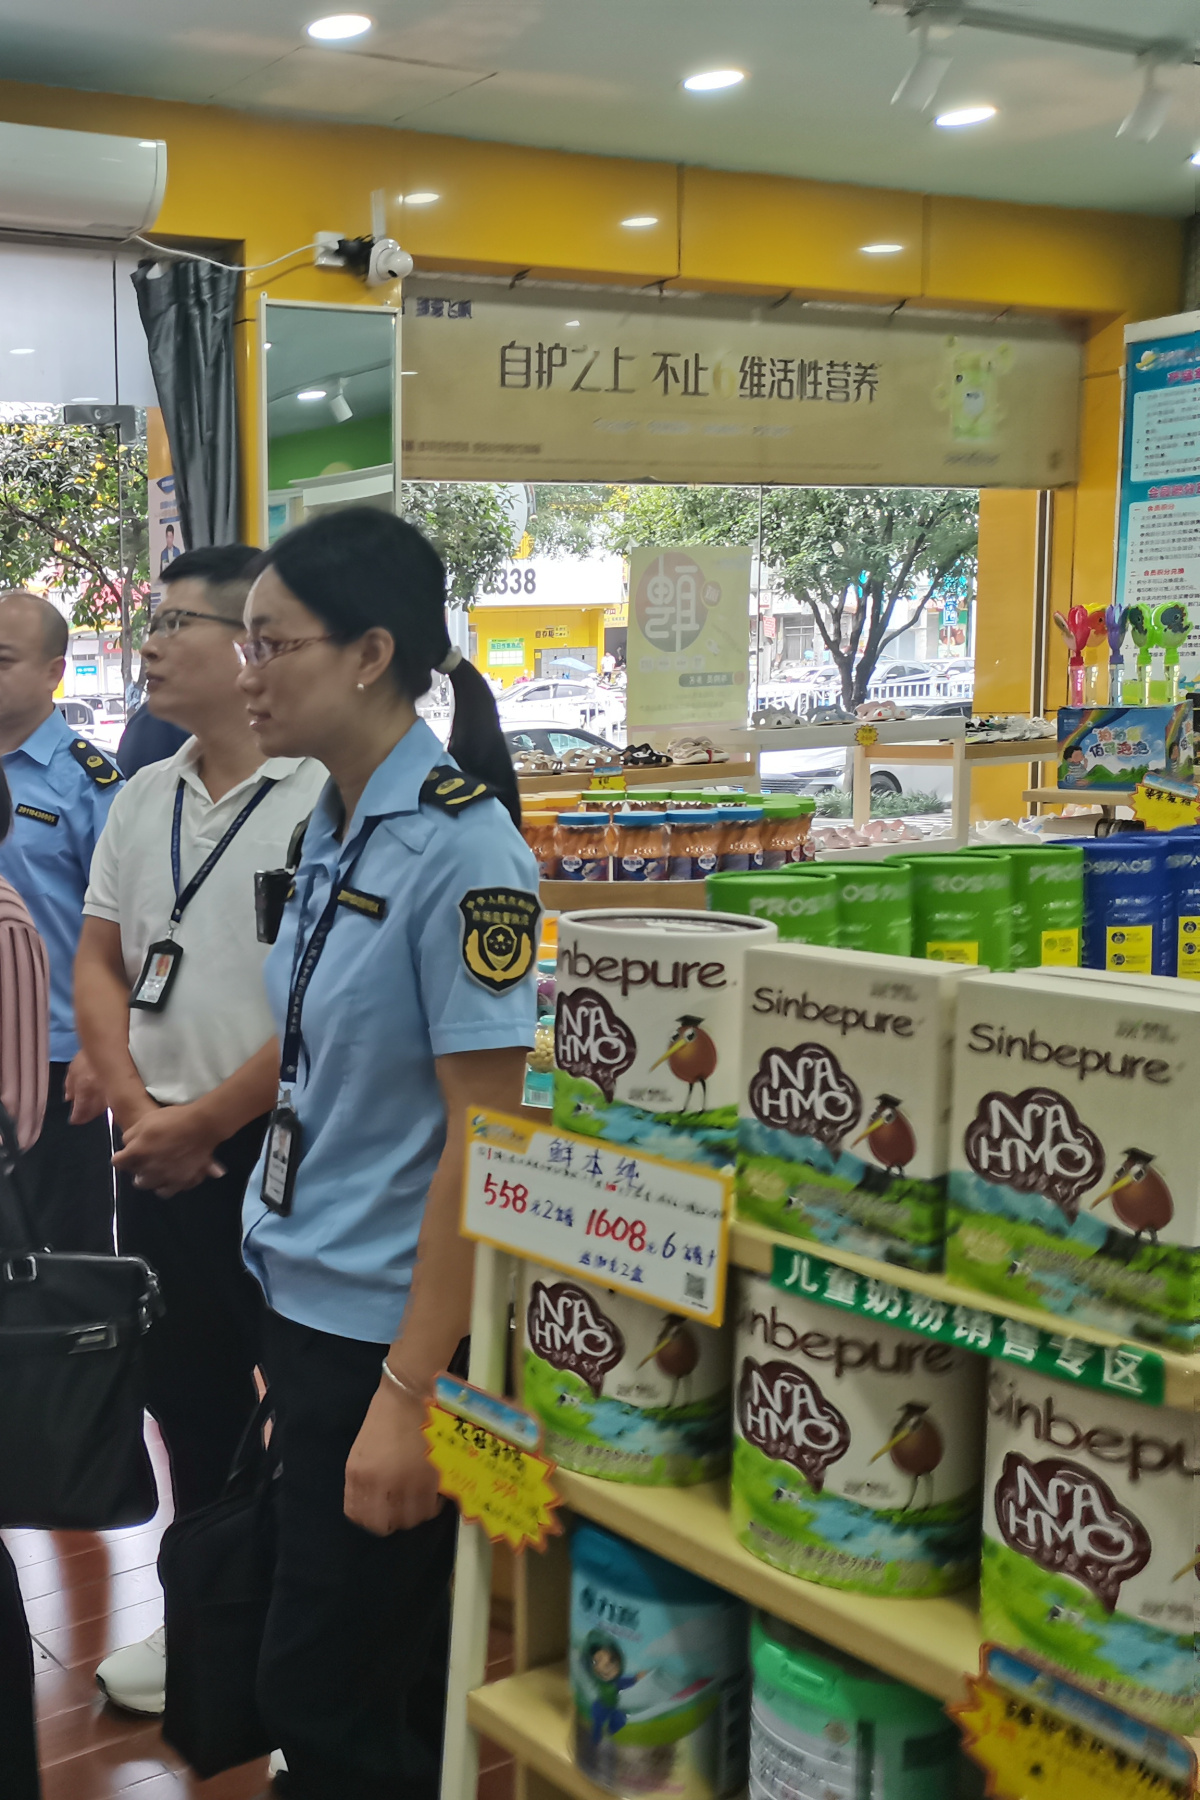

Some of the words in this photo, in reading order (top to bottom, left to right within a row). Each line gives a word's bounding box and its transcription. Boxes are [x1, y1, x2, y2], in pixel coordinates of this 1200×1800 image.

[500, 340, 637, 393] 自护之上
[561, 1004, 616, 1038] NA
[751, 986, 915, 1038] Sinbepure
[558, 1034, 627, 1065] HMO
[769, 1053, 840, 1091] NA
[967, 1021, 1173, 1085] Sinbepure
[761, 1087, 853, 1122] HMO
[988, 1099, 1085, 1144] NA
[980, 1135, 1094, 1178] HMO
[538, 1289, 605, 1331] NA
[784, 1253, 1145, 1395] 儿童奶粉销售专区
[535, 1318, 613, 1357] HMO
[751, 1369, 832, 1421] NA
[746, 1401, 840, 1450] HMO
[1016, 1464, 1123, 1527] NA
[1008, 1500, 1134, 1562] HMO
